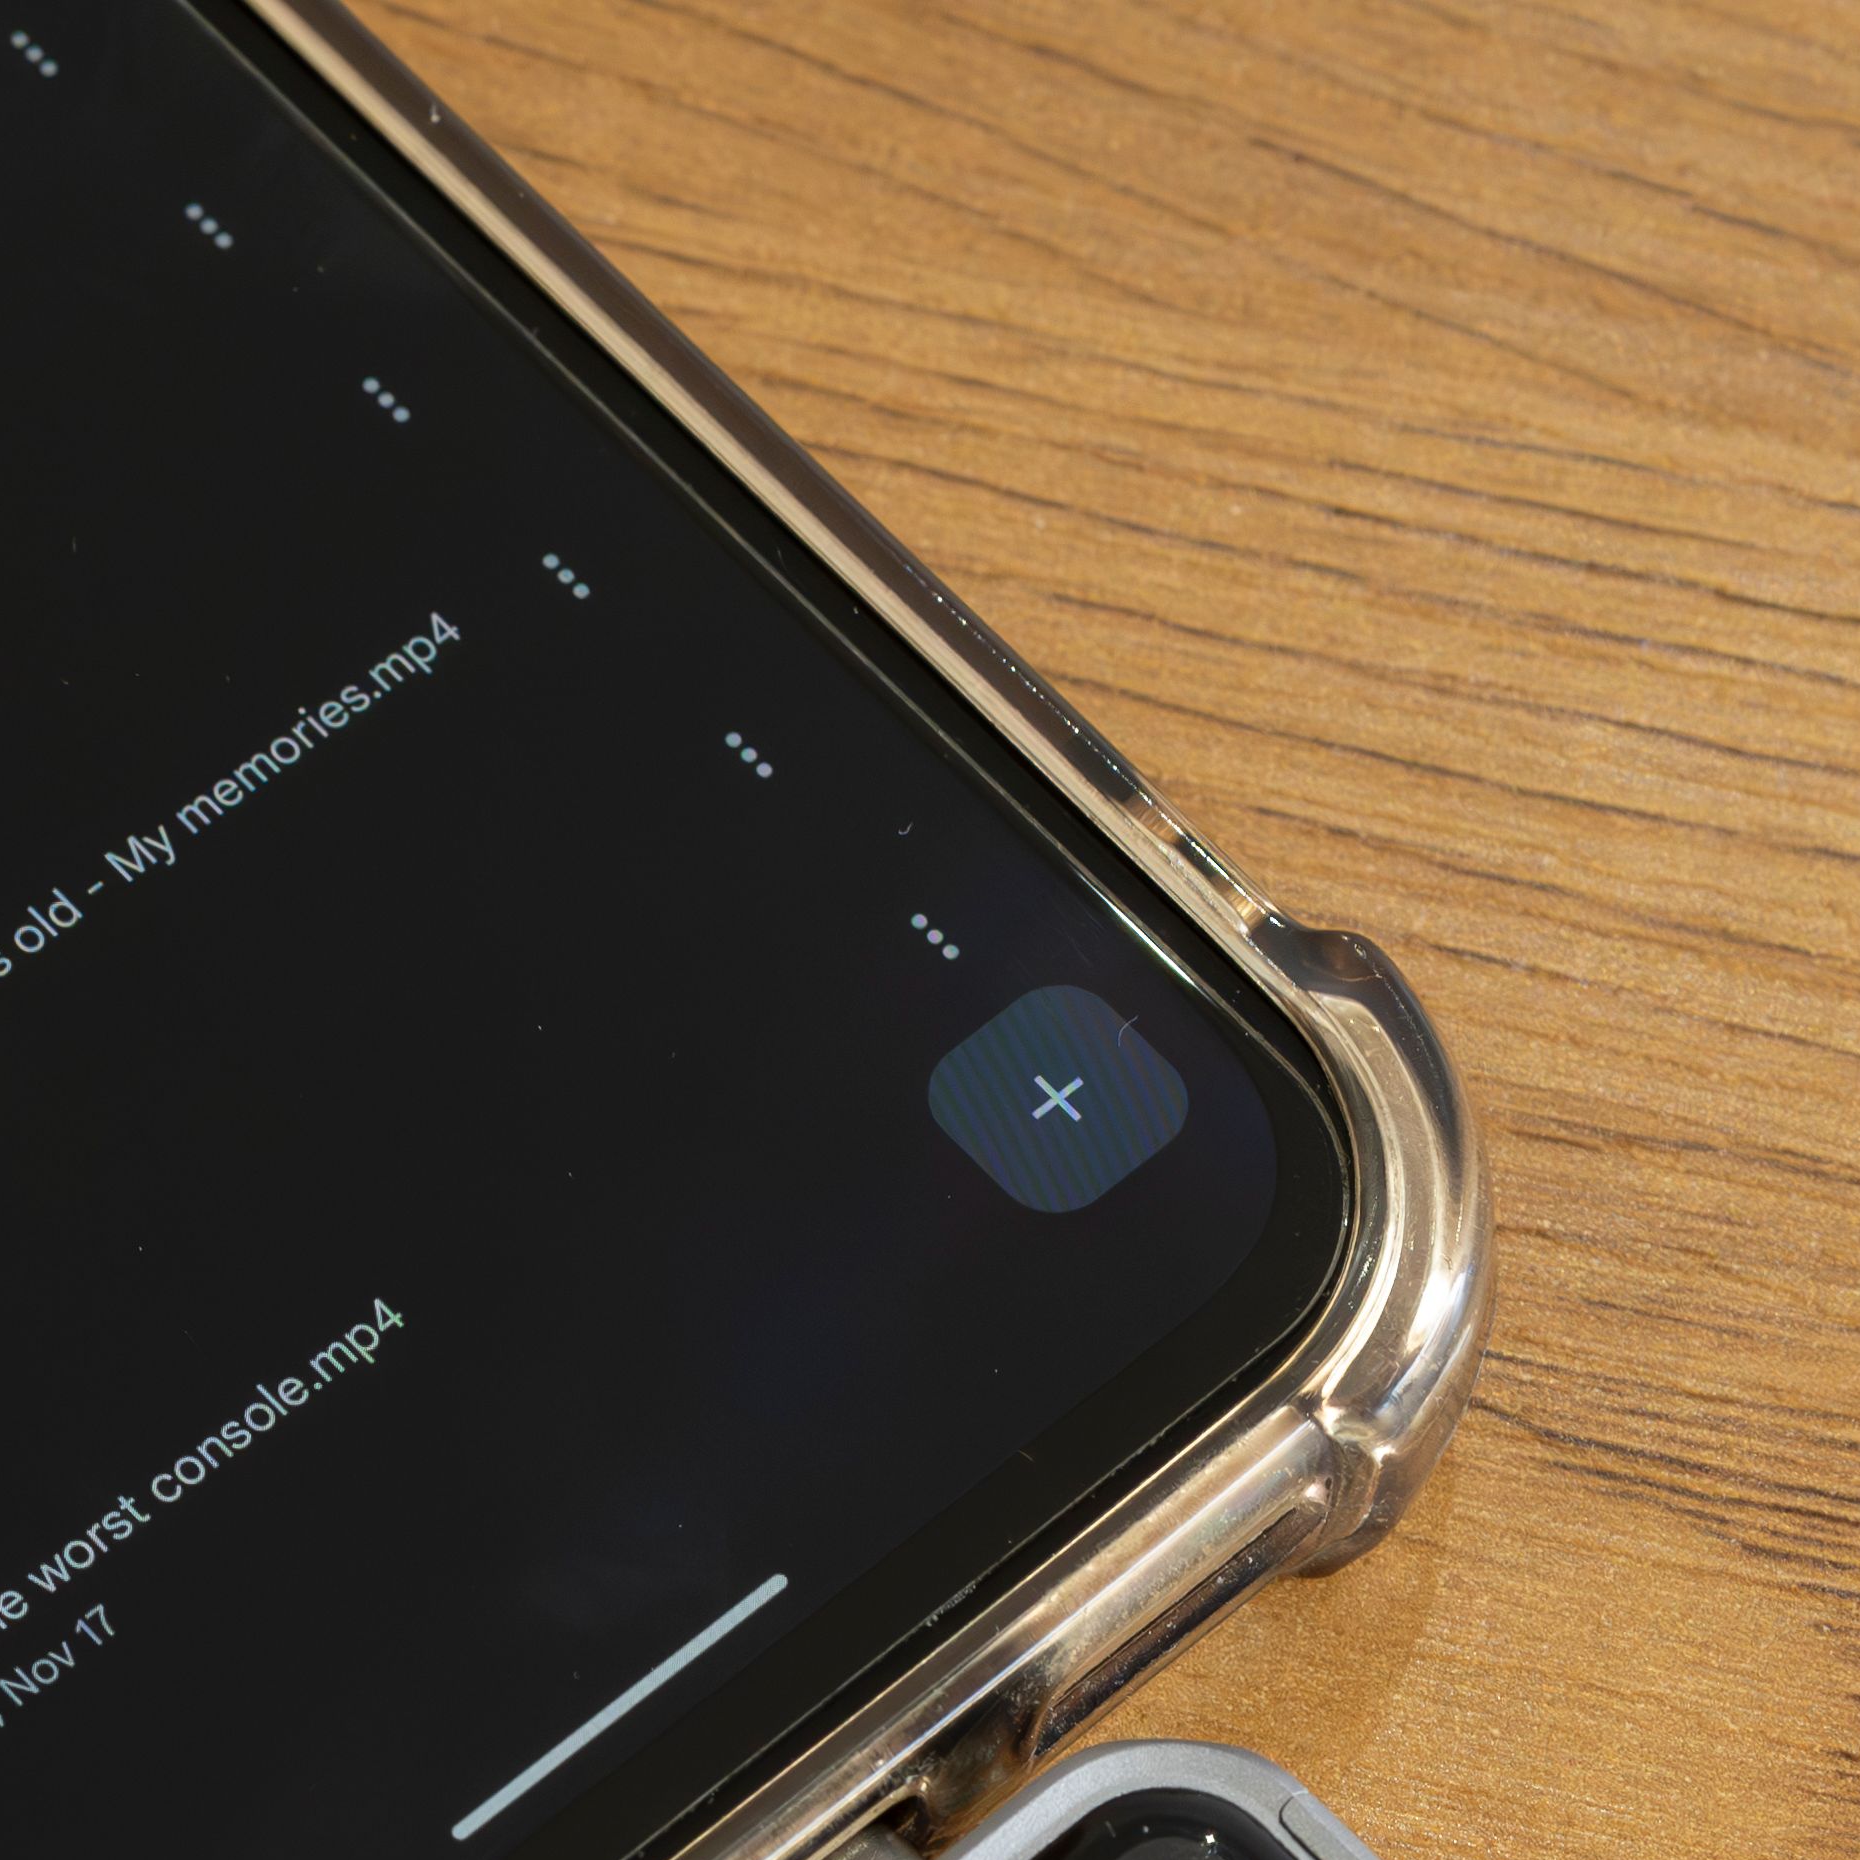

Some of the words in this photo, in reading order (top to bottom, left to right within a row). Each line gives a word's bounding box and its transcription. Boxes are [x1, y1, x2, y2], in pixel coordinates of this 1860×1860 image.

[13, 886, 83, 953] old
[103, 824, 176, 882] My
[175, 611, 460, 834] memories.mp4
[26, 1495, 151, 1593] worst
[150, 1297, 404, 1503] console.mp4
[74, 1603, 114, 1645] 17
